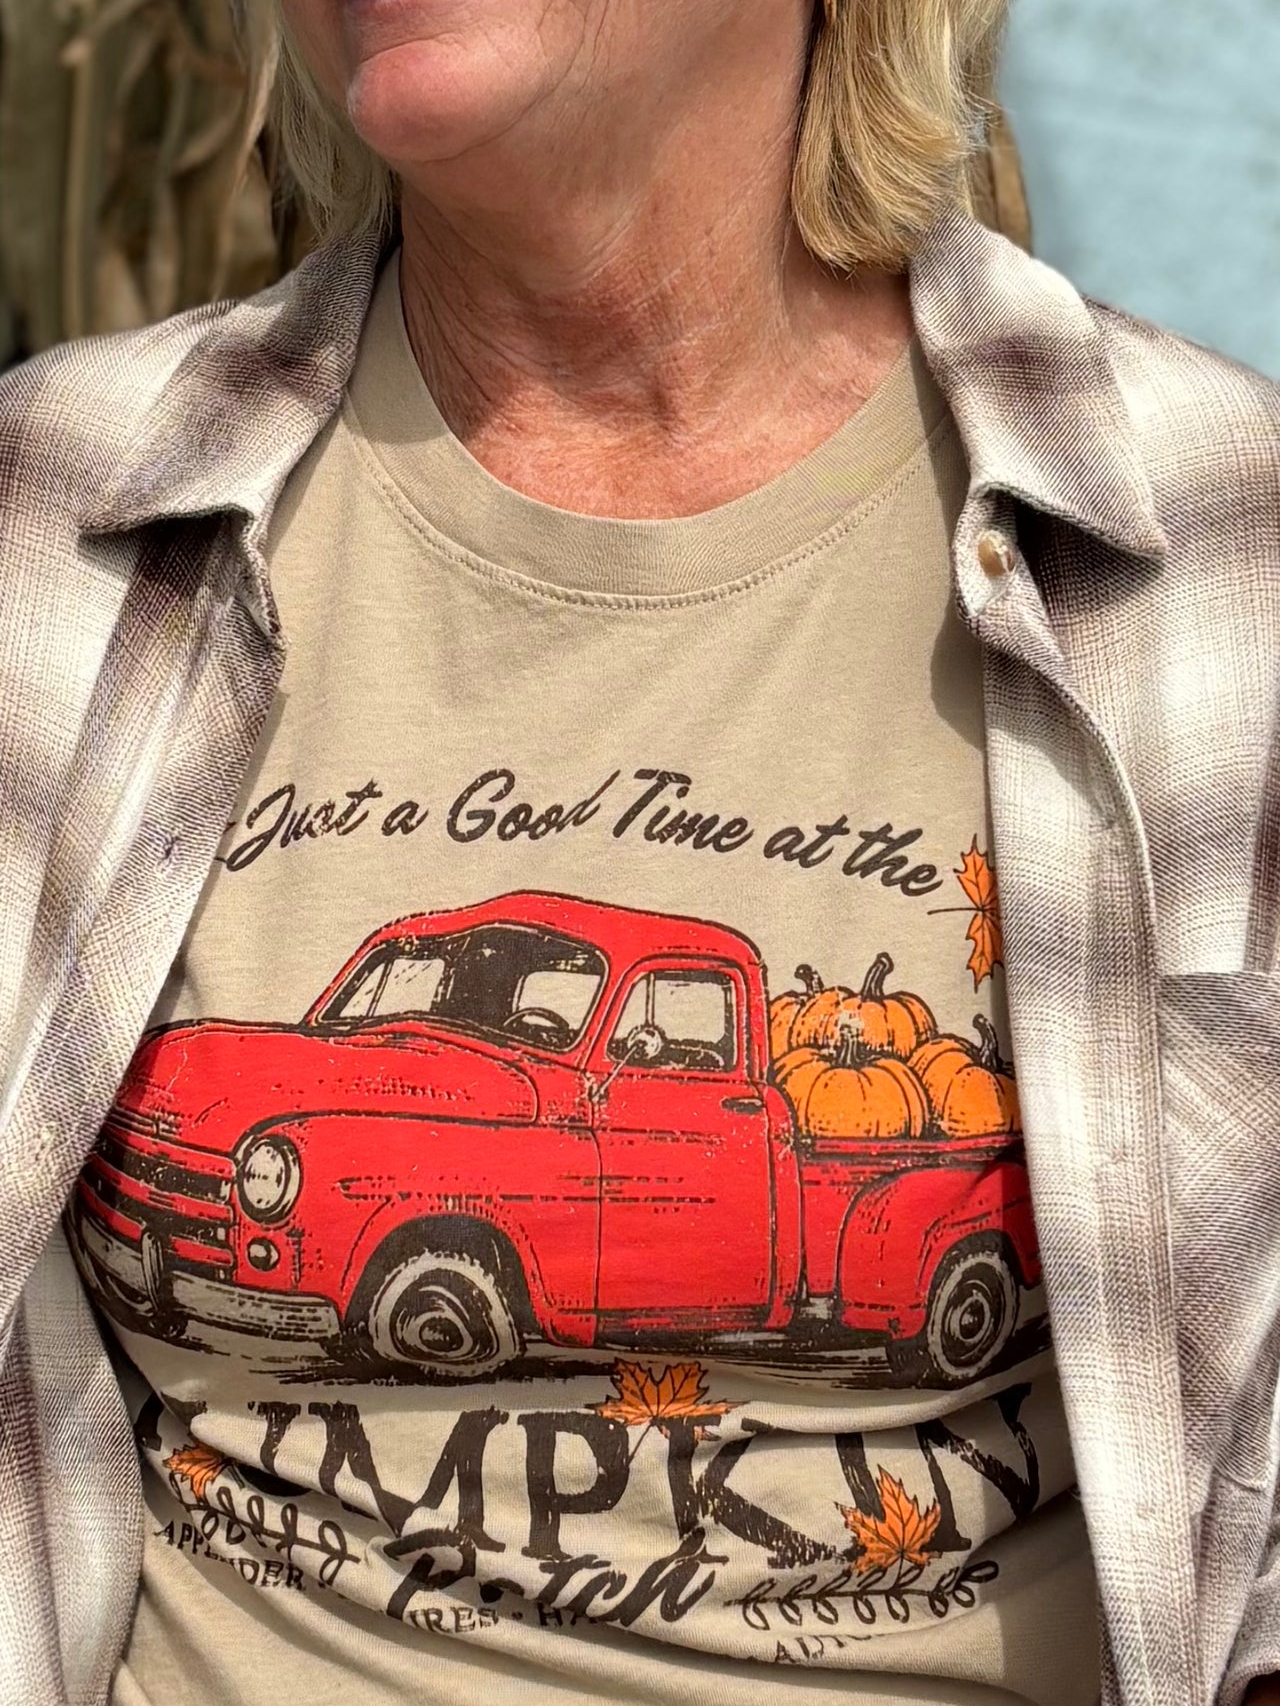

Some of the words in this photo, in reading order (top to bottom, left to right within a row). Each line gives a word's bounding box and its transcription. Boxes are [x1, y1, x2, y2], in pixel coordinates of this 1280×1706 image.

[219, 780, 383, 872] Just
[380, 799, 429, 837] a
[446, 768, 620, 843] Good
[612, 768, 754, 853] Time
[763, 814, 850, 868] at
[841, 823, 944, 896] the
